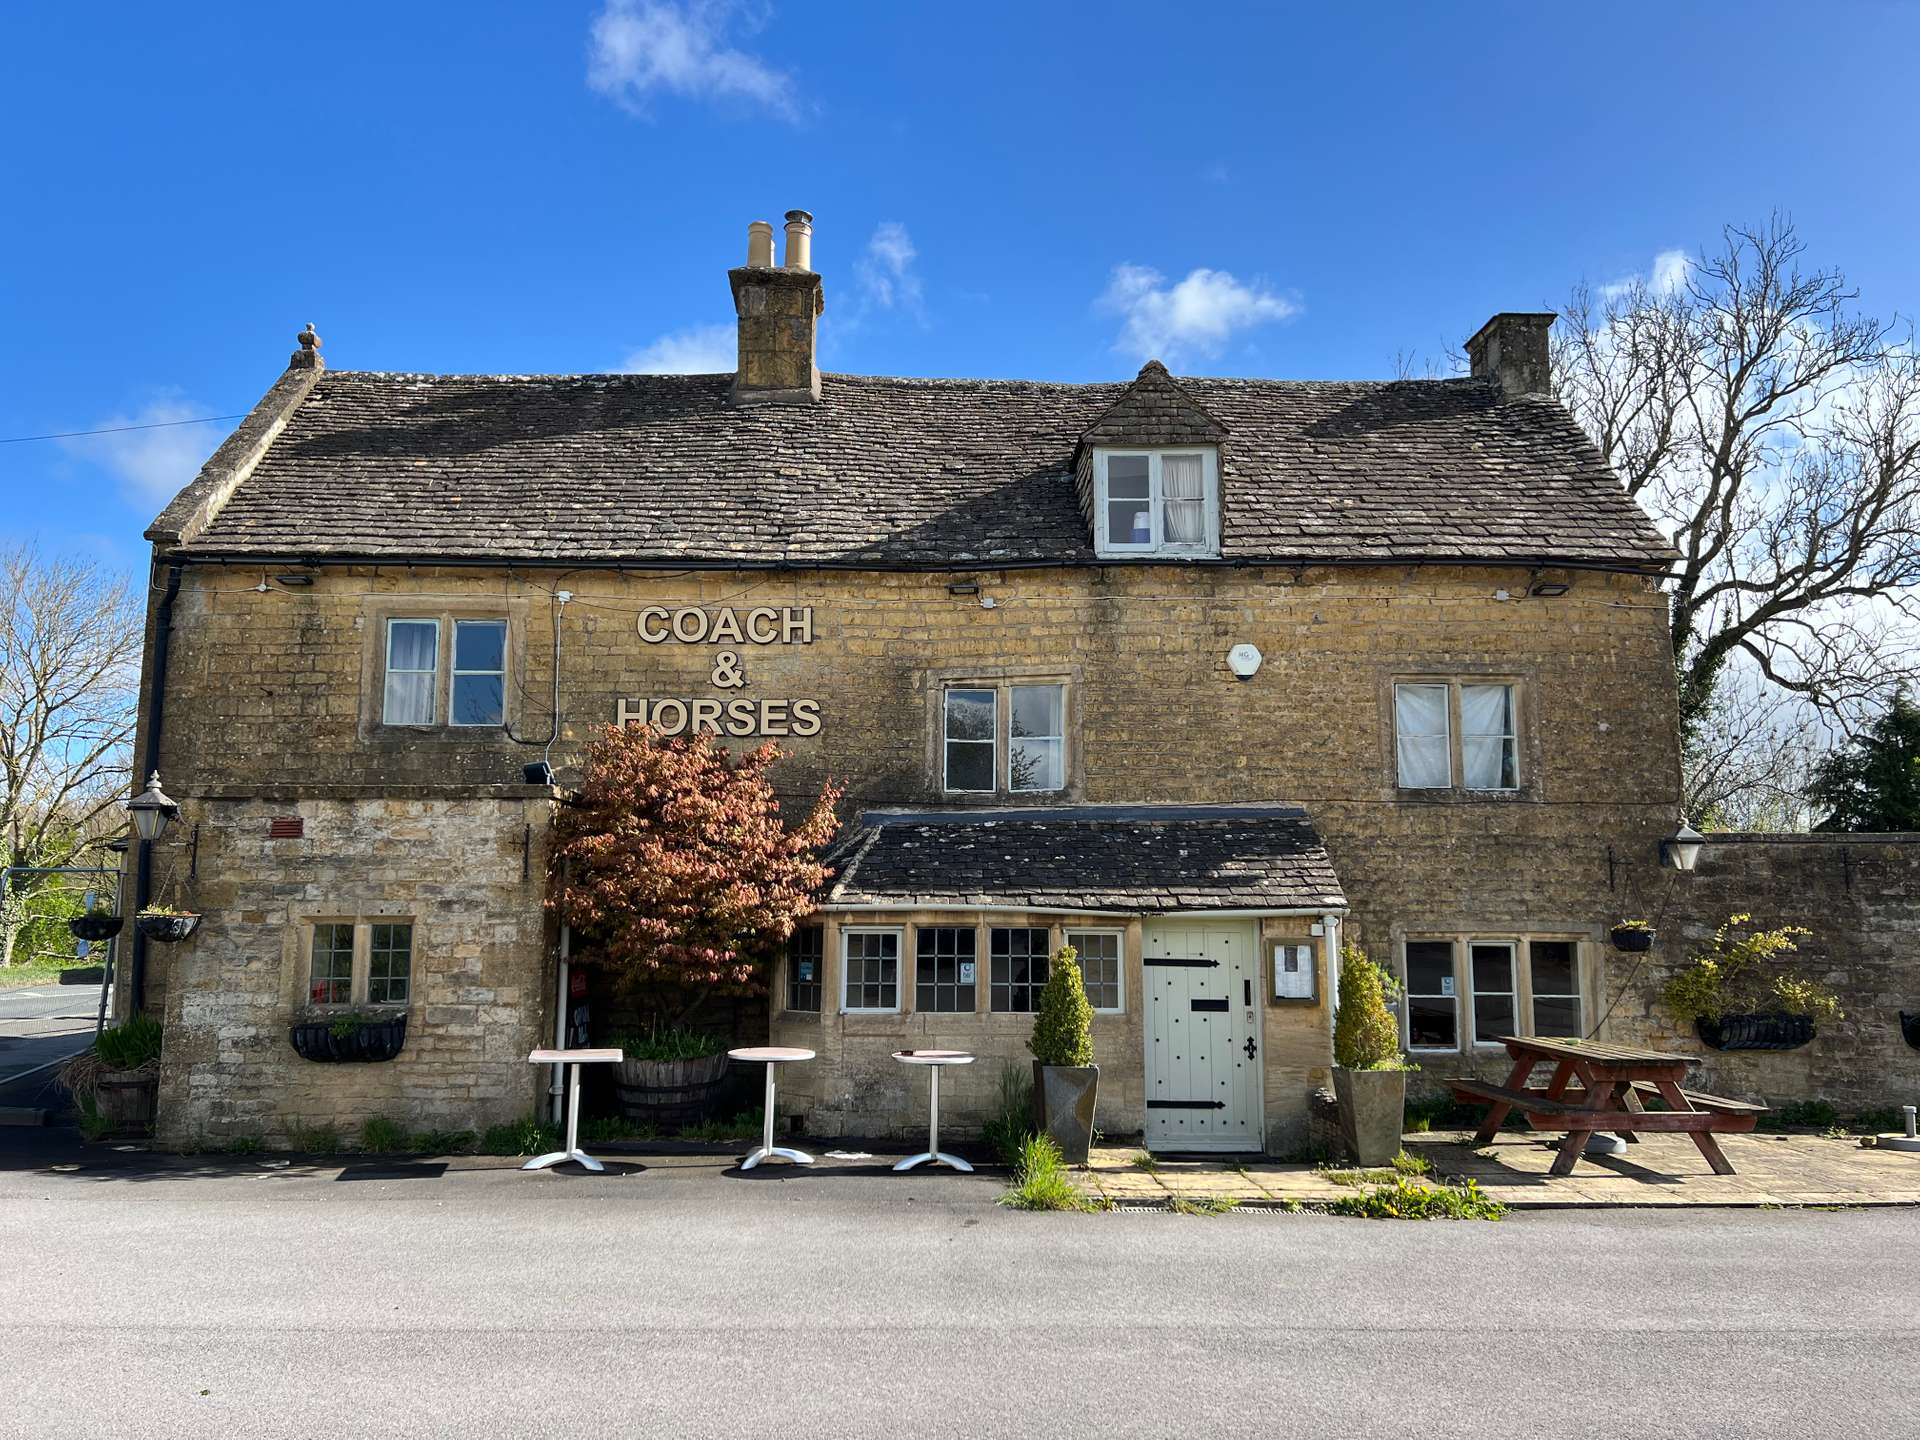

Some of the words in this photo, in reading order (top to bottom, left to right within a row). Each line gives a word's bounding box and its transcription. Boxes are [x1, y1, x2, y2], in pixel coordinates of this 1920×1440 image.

[637, 605, 814, 644] COACH
[711, 650, 745, 688] &
[616, 697, 822, 736] HORSES
